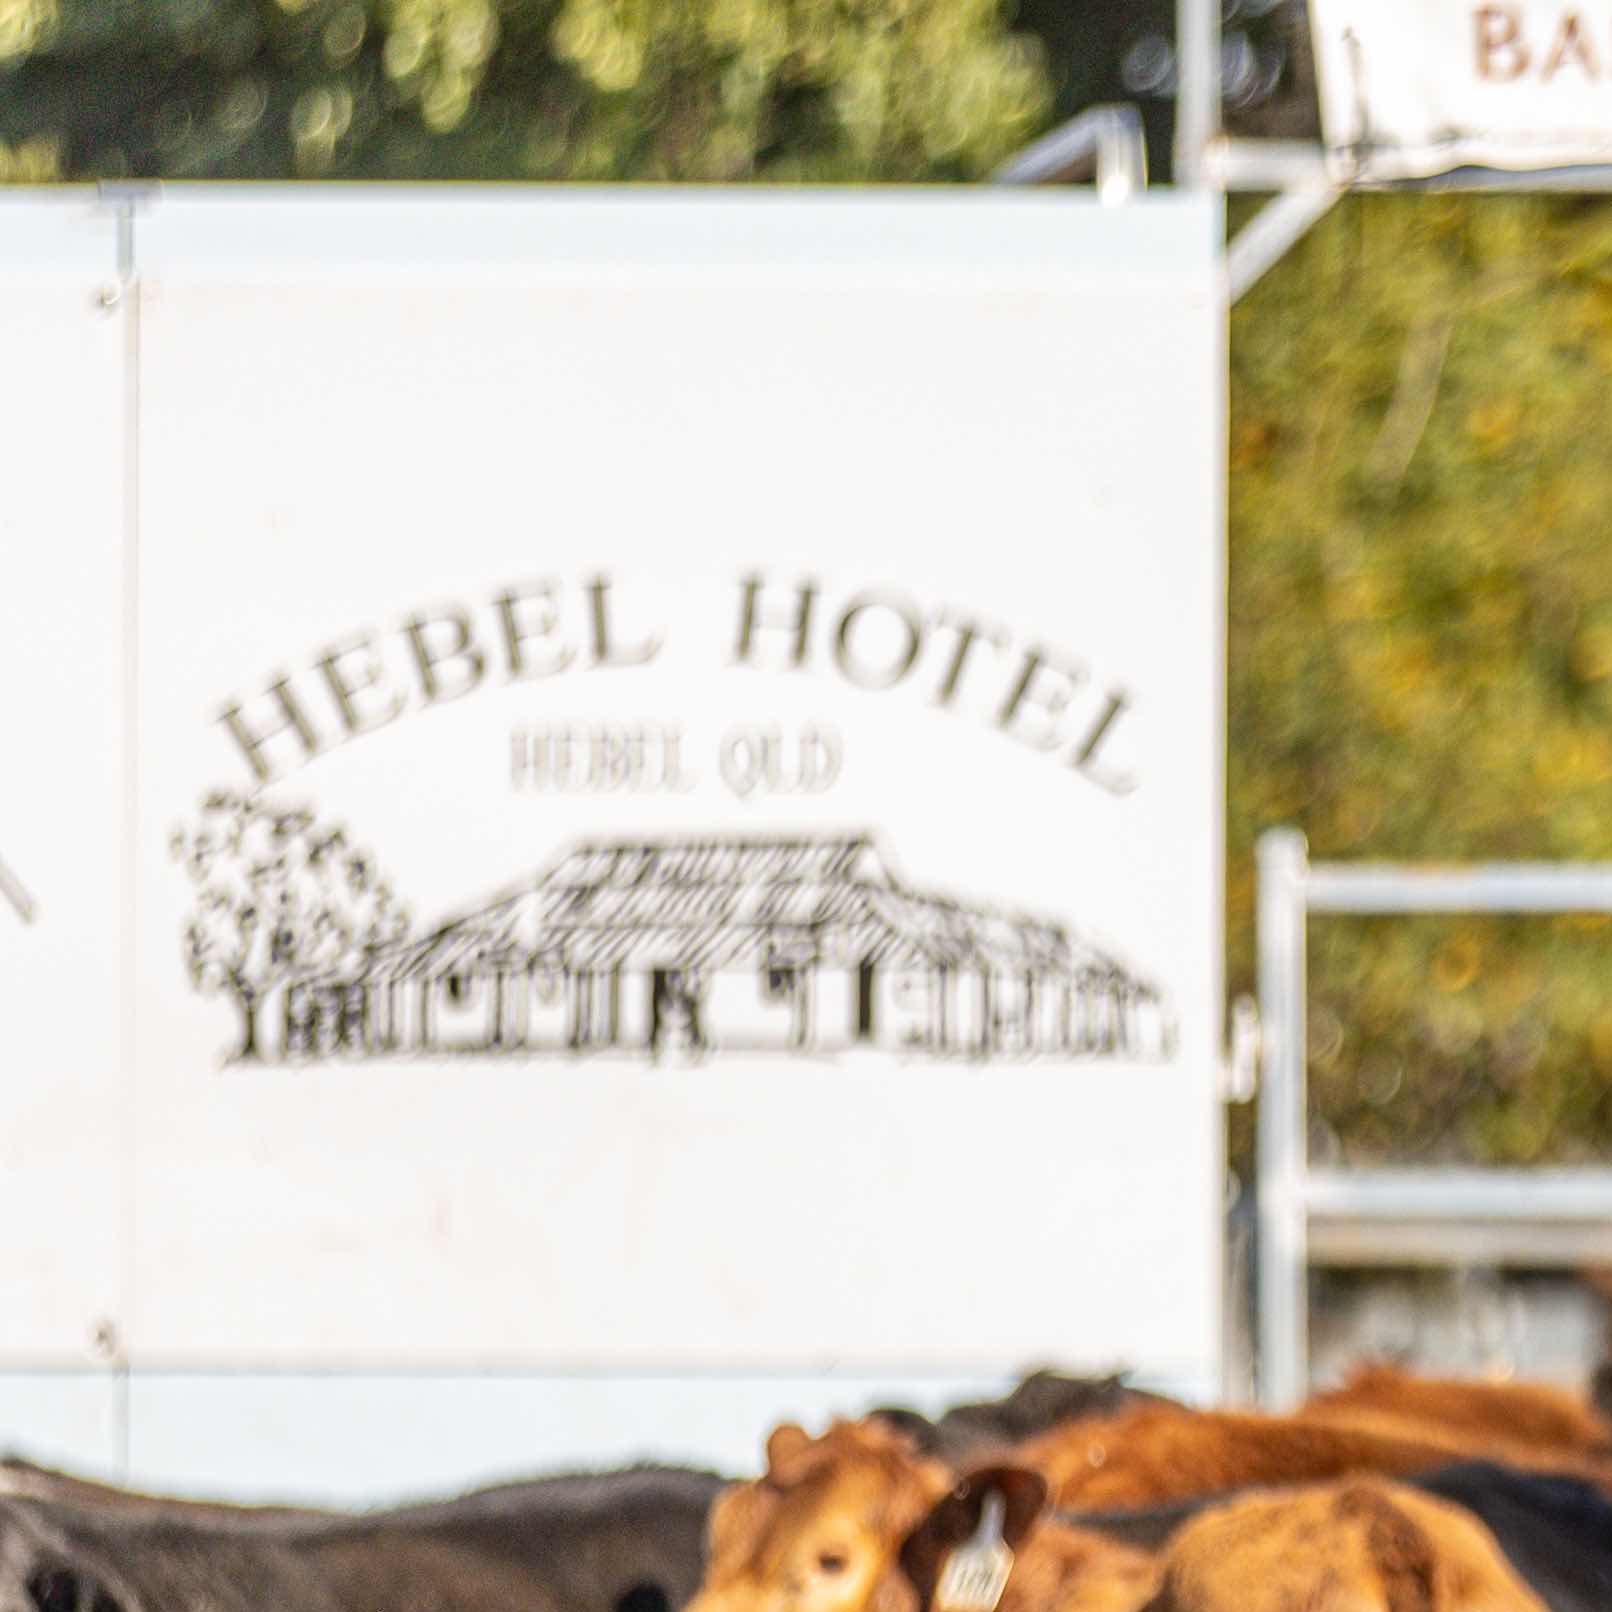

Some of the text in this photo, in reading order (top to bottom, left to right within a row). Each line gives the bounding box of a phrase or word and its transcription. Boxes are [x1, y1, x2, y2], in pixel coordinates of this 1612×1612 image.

[212, 570, 1140, 796] HEBEL HOTEL
[510, 724, 842, 801] HEBEL QLD
